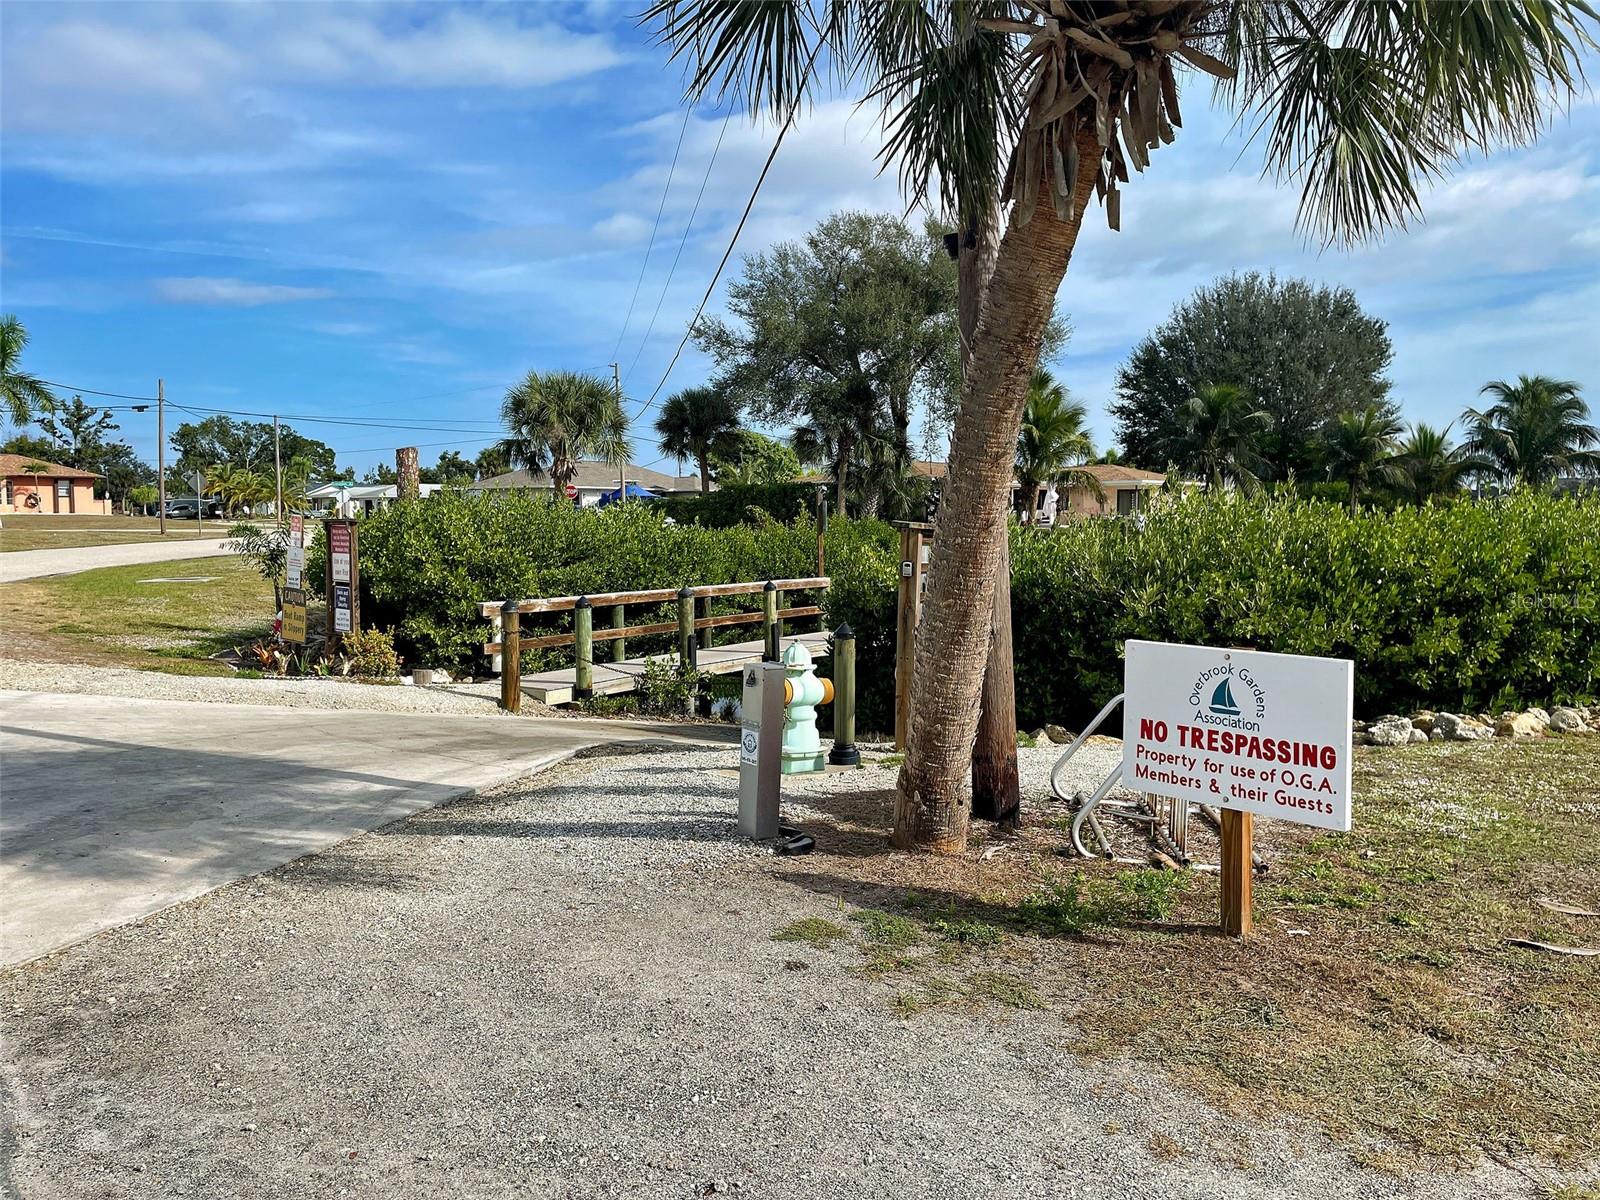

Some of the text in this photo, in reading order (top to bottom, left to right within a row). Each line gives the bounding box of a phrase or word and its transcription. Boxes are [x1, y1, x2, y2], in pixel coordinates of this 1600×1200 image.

[288, 623, 304, 636] Slippery
[294, 612, 305, 624] Ramp
[1189, 663, 1234, 706] Overbrook
[1239, 668, 1265, 719] Gardens
[1194, 709, 1260, 732] Association
[1140, 718, 1336, 770] NO TRESPASSING
[1135, 763, 1333, 814] Members & their Guests
[1136, 744, 1337, 794] Property for use of O.G.A.
